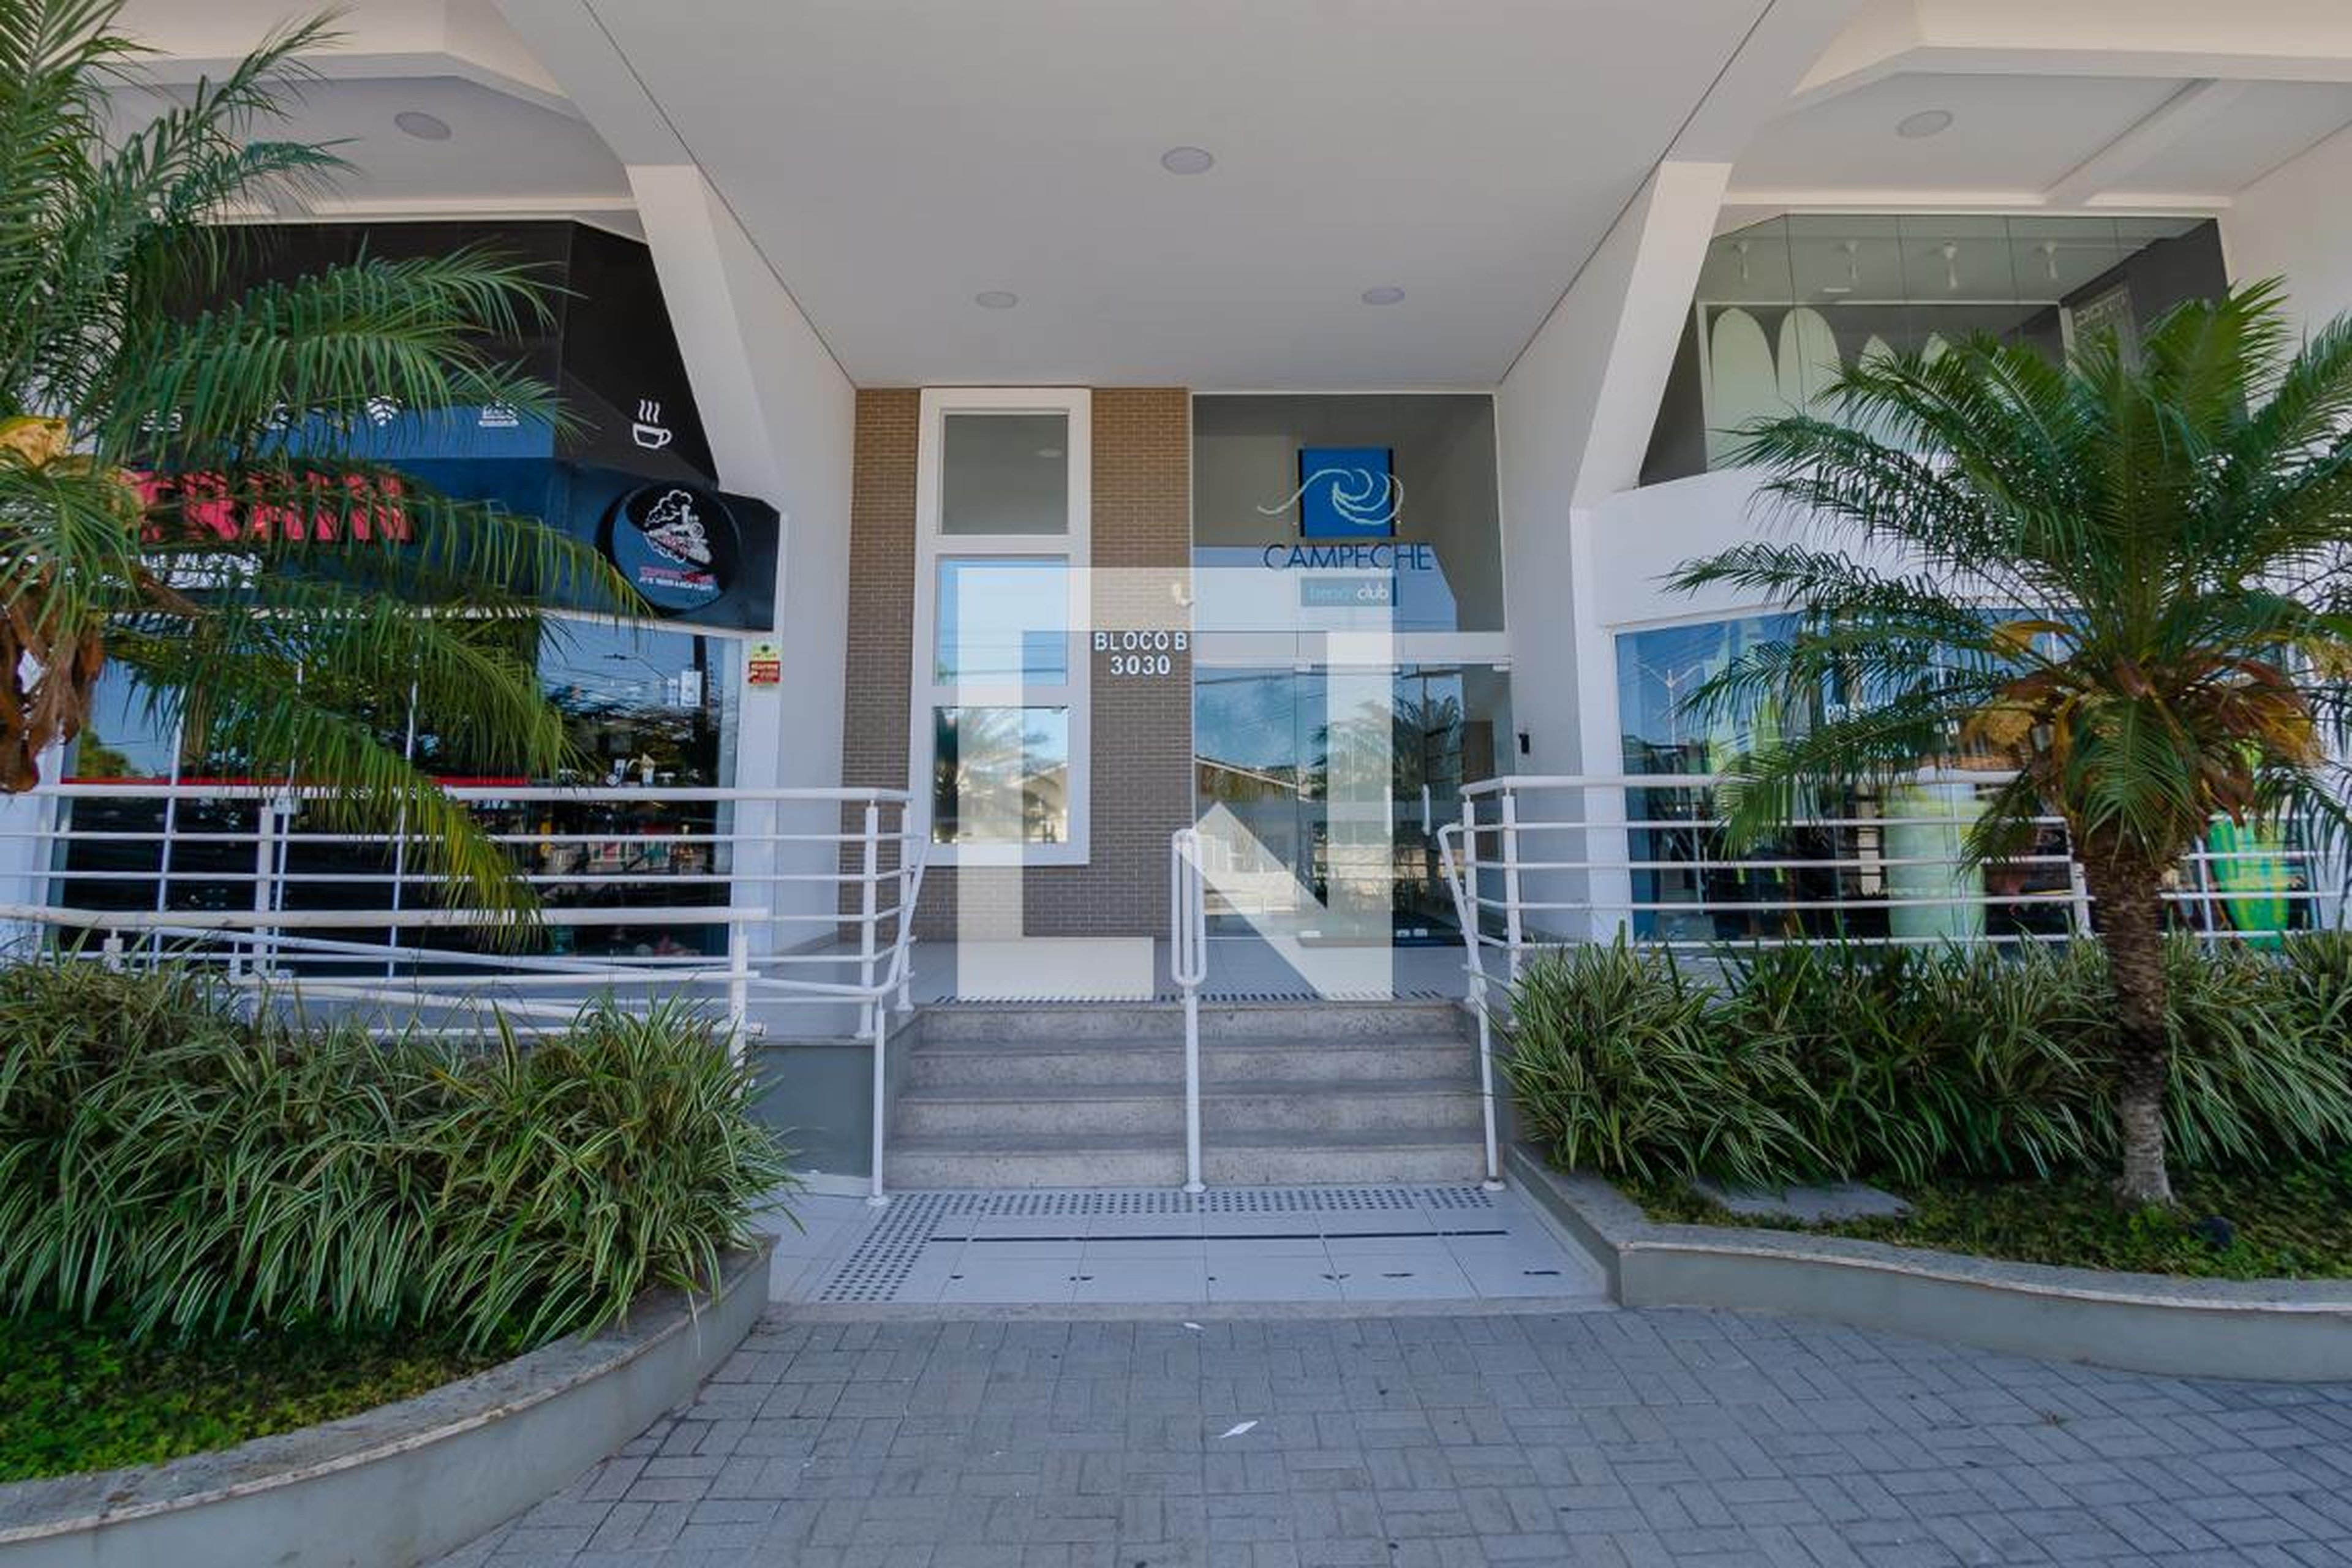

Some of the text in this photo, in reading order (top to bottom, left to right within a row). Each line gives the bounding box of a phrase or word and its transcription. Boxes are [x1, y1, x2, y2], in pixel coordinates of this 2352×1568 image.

[1263, 542, 1433, 570] CAMPECHE
[1357, 582, 1389, 600] club
[1095, 631, 1188, 650] BLOCO B
[1110, 655, 1170, 675] 3030
